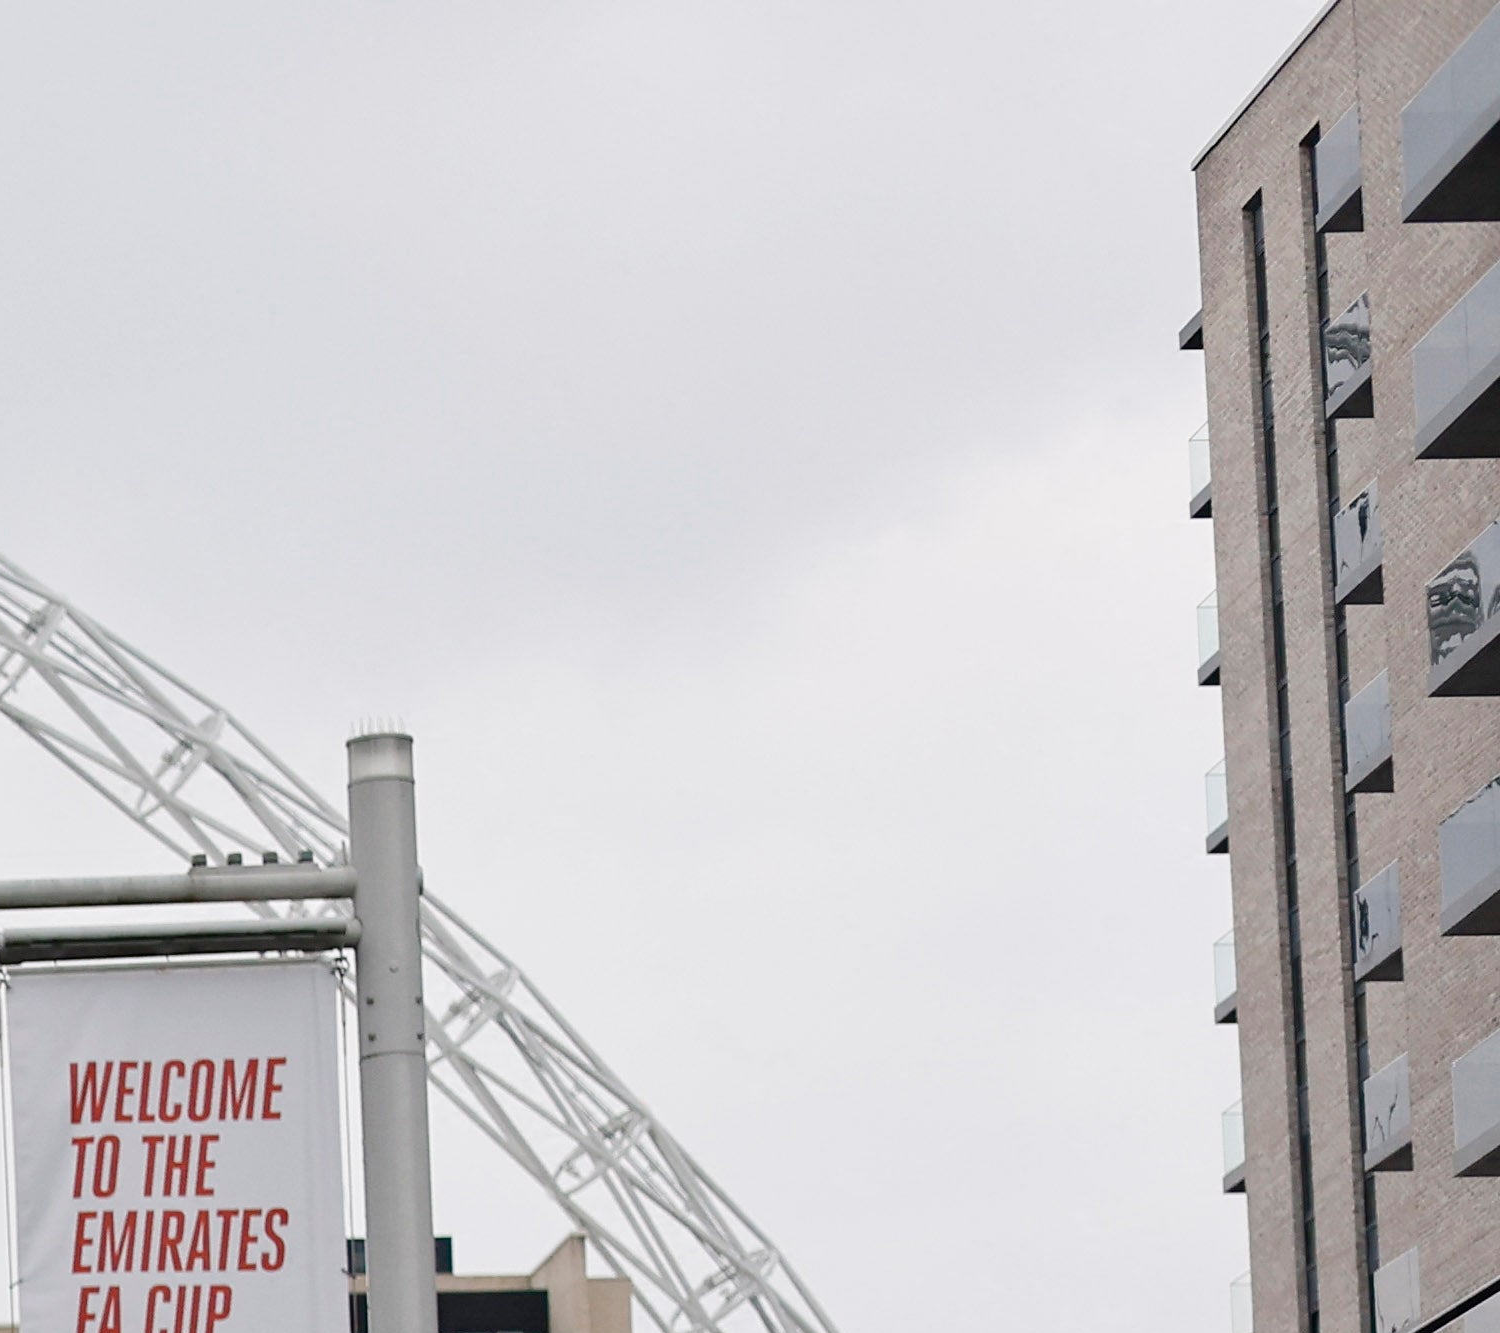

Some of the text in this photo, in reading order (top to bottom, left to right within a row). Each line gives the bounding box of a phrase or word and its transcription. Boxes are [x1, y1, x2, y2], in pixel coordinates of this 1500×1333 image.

[69, 1057, 287, 1124] WELCOME
[72, 1134, 220, 1199] TO THE
[72, 1208, 289, 1274] EMIRATES
